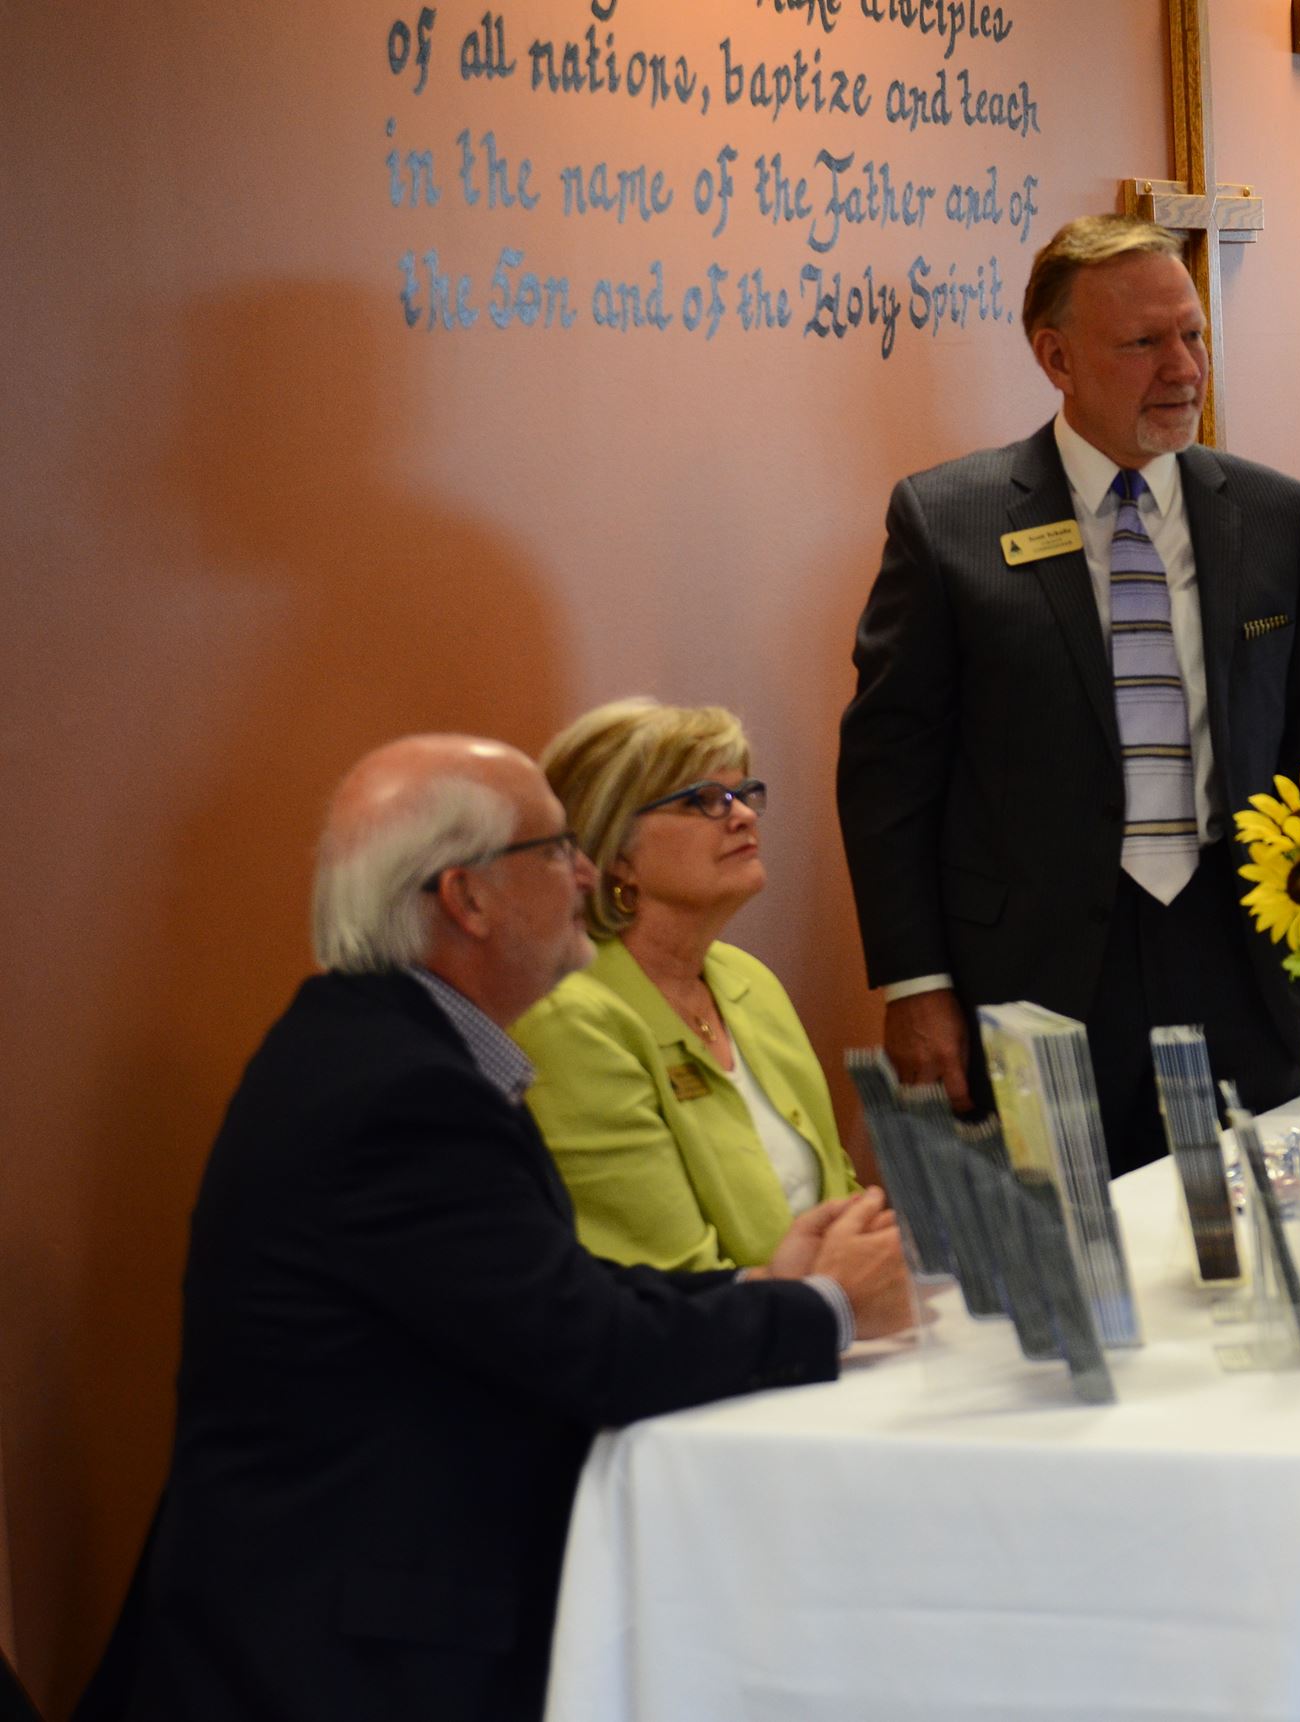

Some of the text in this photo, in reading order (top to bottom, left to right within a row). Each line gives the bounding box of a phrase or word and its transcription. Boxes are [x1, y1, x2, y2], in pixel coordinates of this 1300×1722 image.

[387, 7, 437, 96] of
[460, 11, 518, 81] all
[719, 37, 872, 122] baptize
[886, 69, 952, 132] and
[956, 69, 1040, 138] teach
[386, 116, 1039, 253] in the name of the Father and of
[397, 246, 1014, 360] the Son and of the Holy Spirit.
